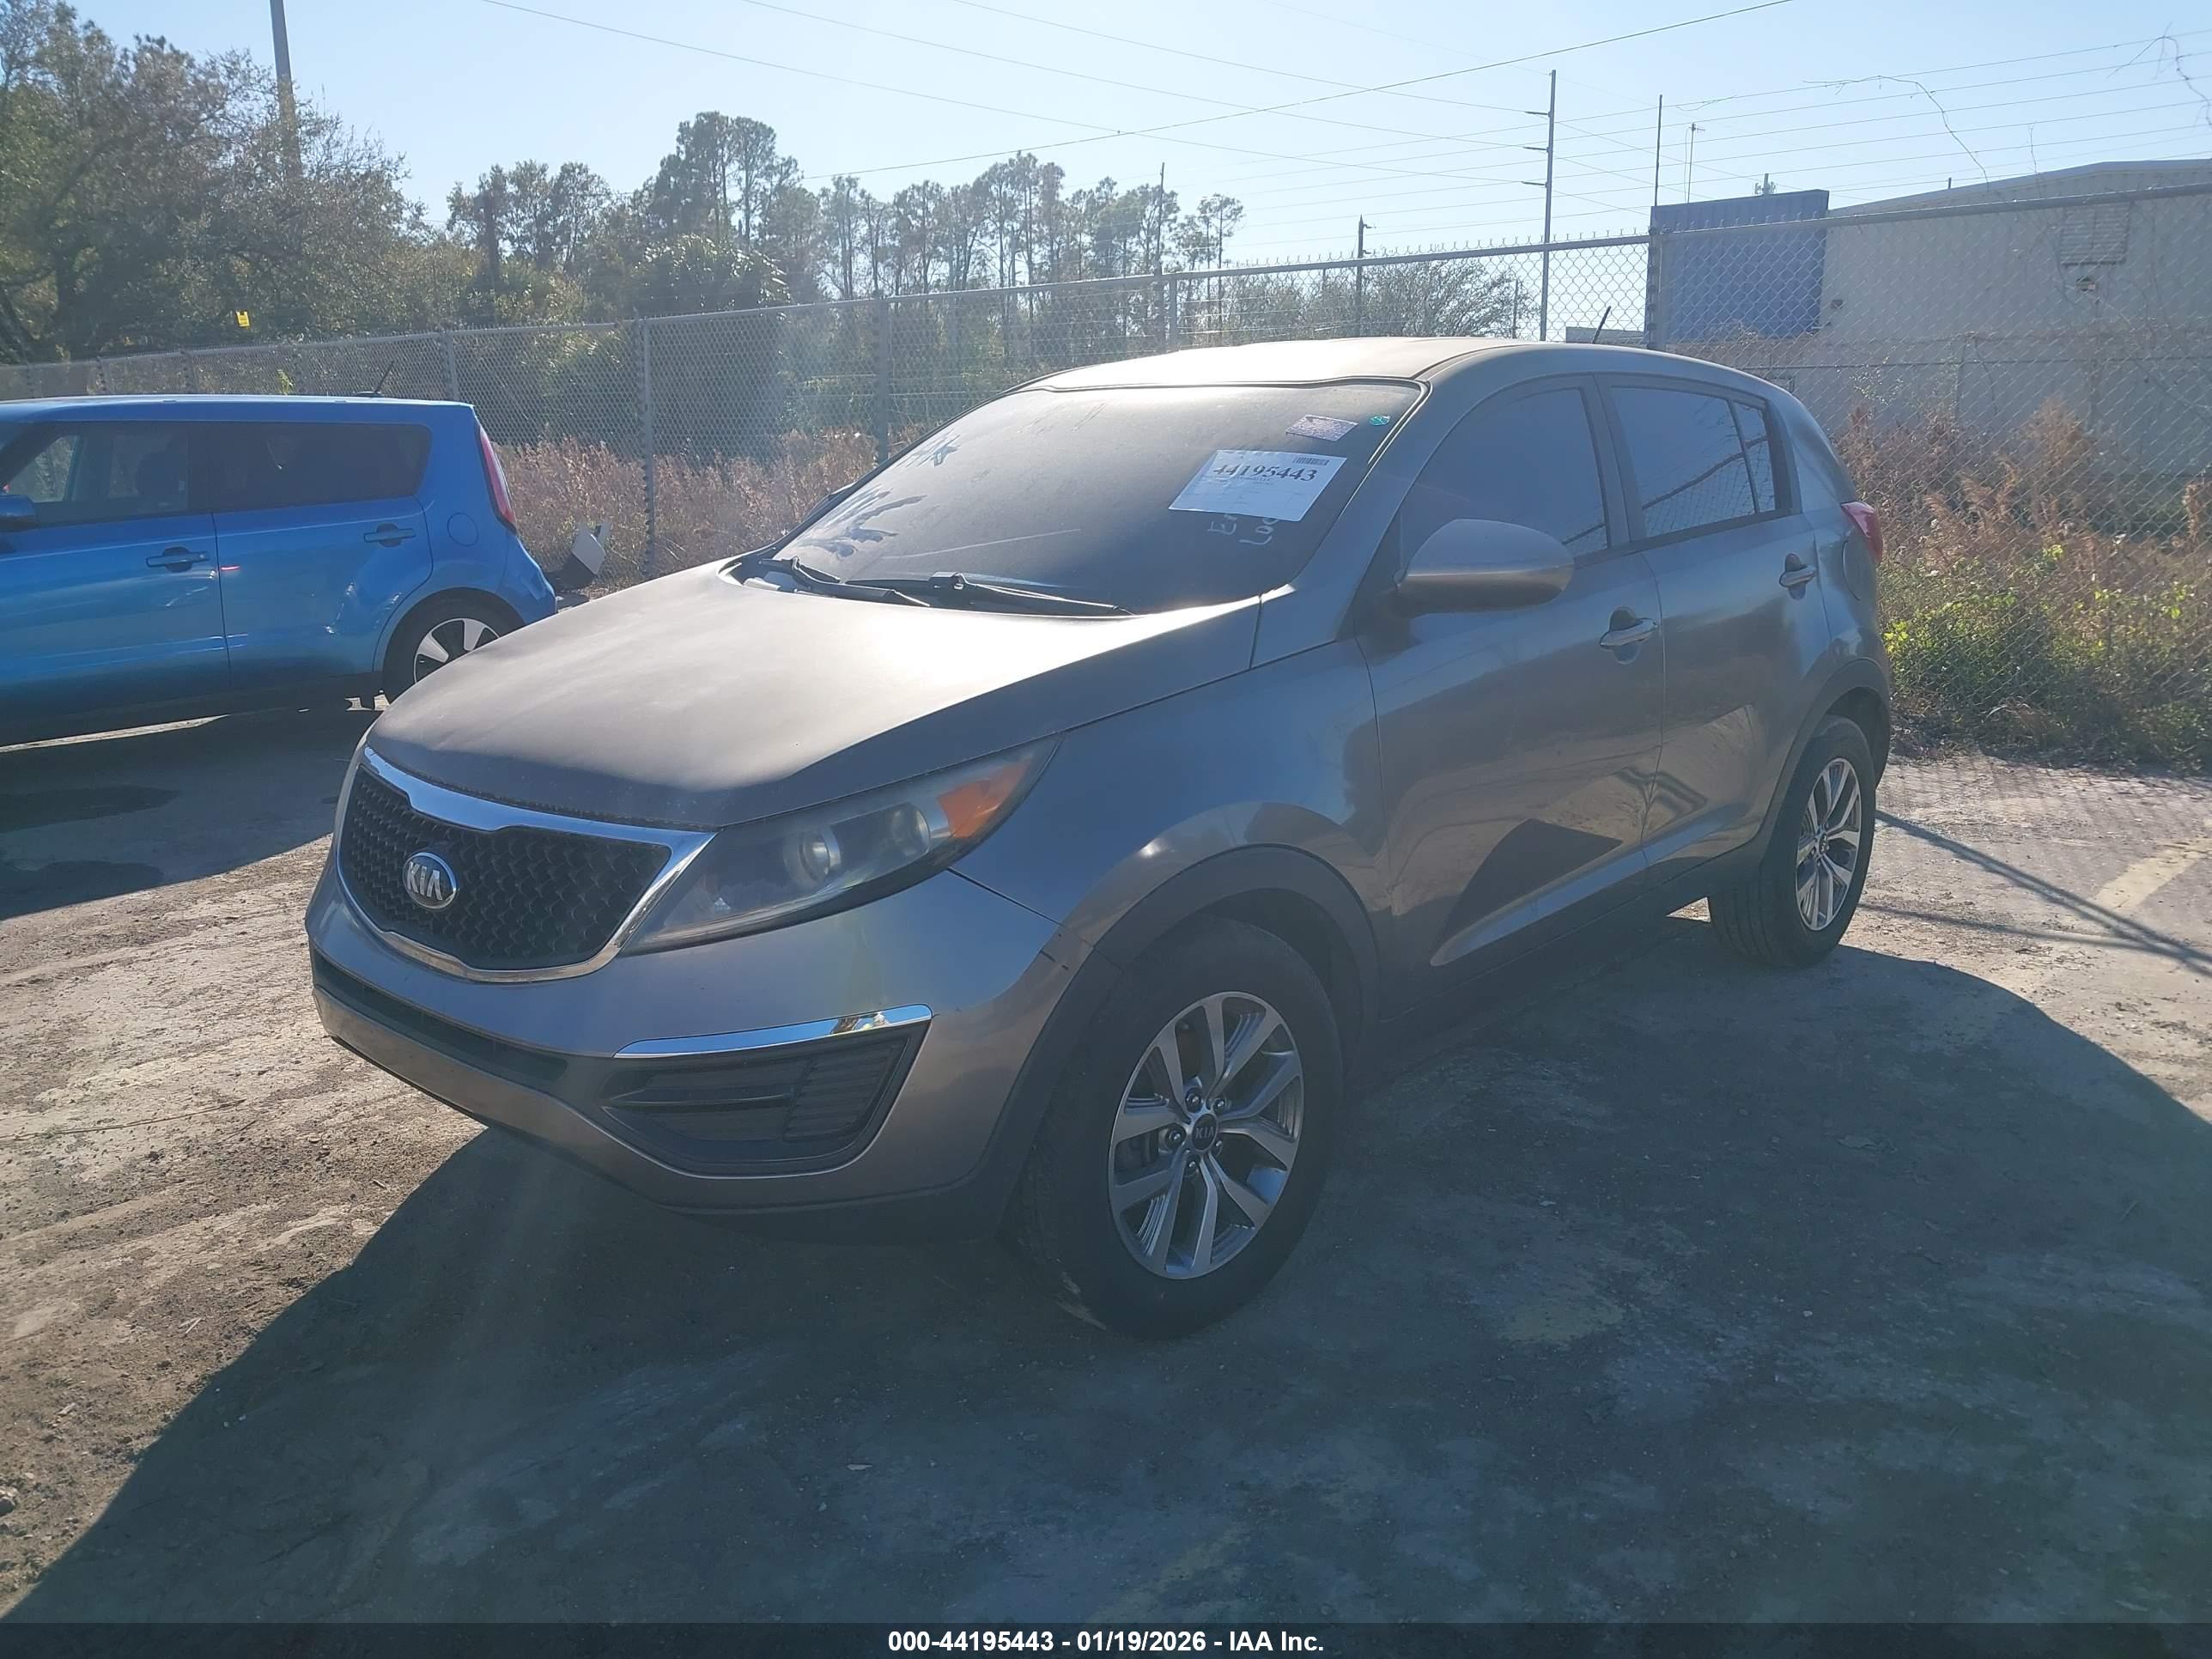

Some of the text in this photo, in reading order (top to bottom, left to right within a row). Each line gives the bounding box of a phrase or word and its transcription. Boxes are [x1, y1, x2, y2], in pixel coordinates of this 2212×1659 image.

[1213, 464, 1317, 481] 44195443
[407, 861, 443, 901] KIA
[1194, 1126, 1214, 1139] KIA
